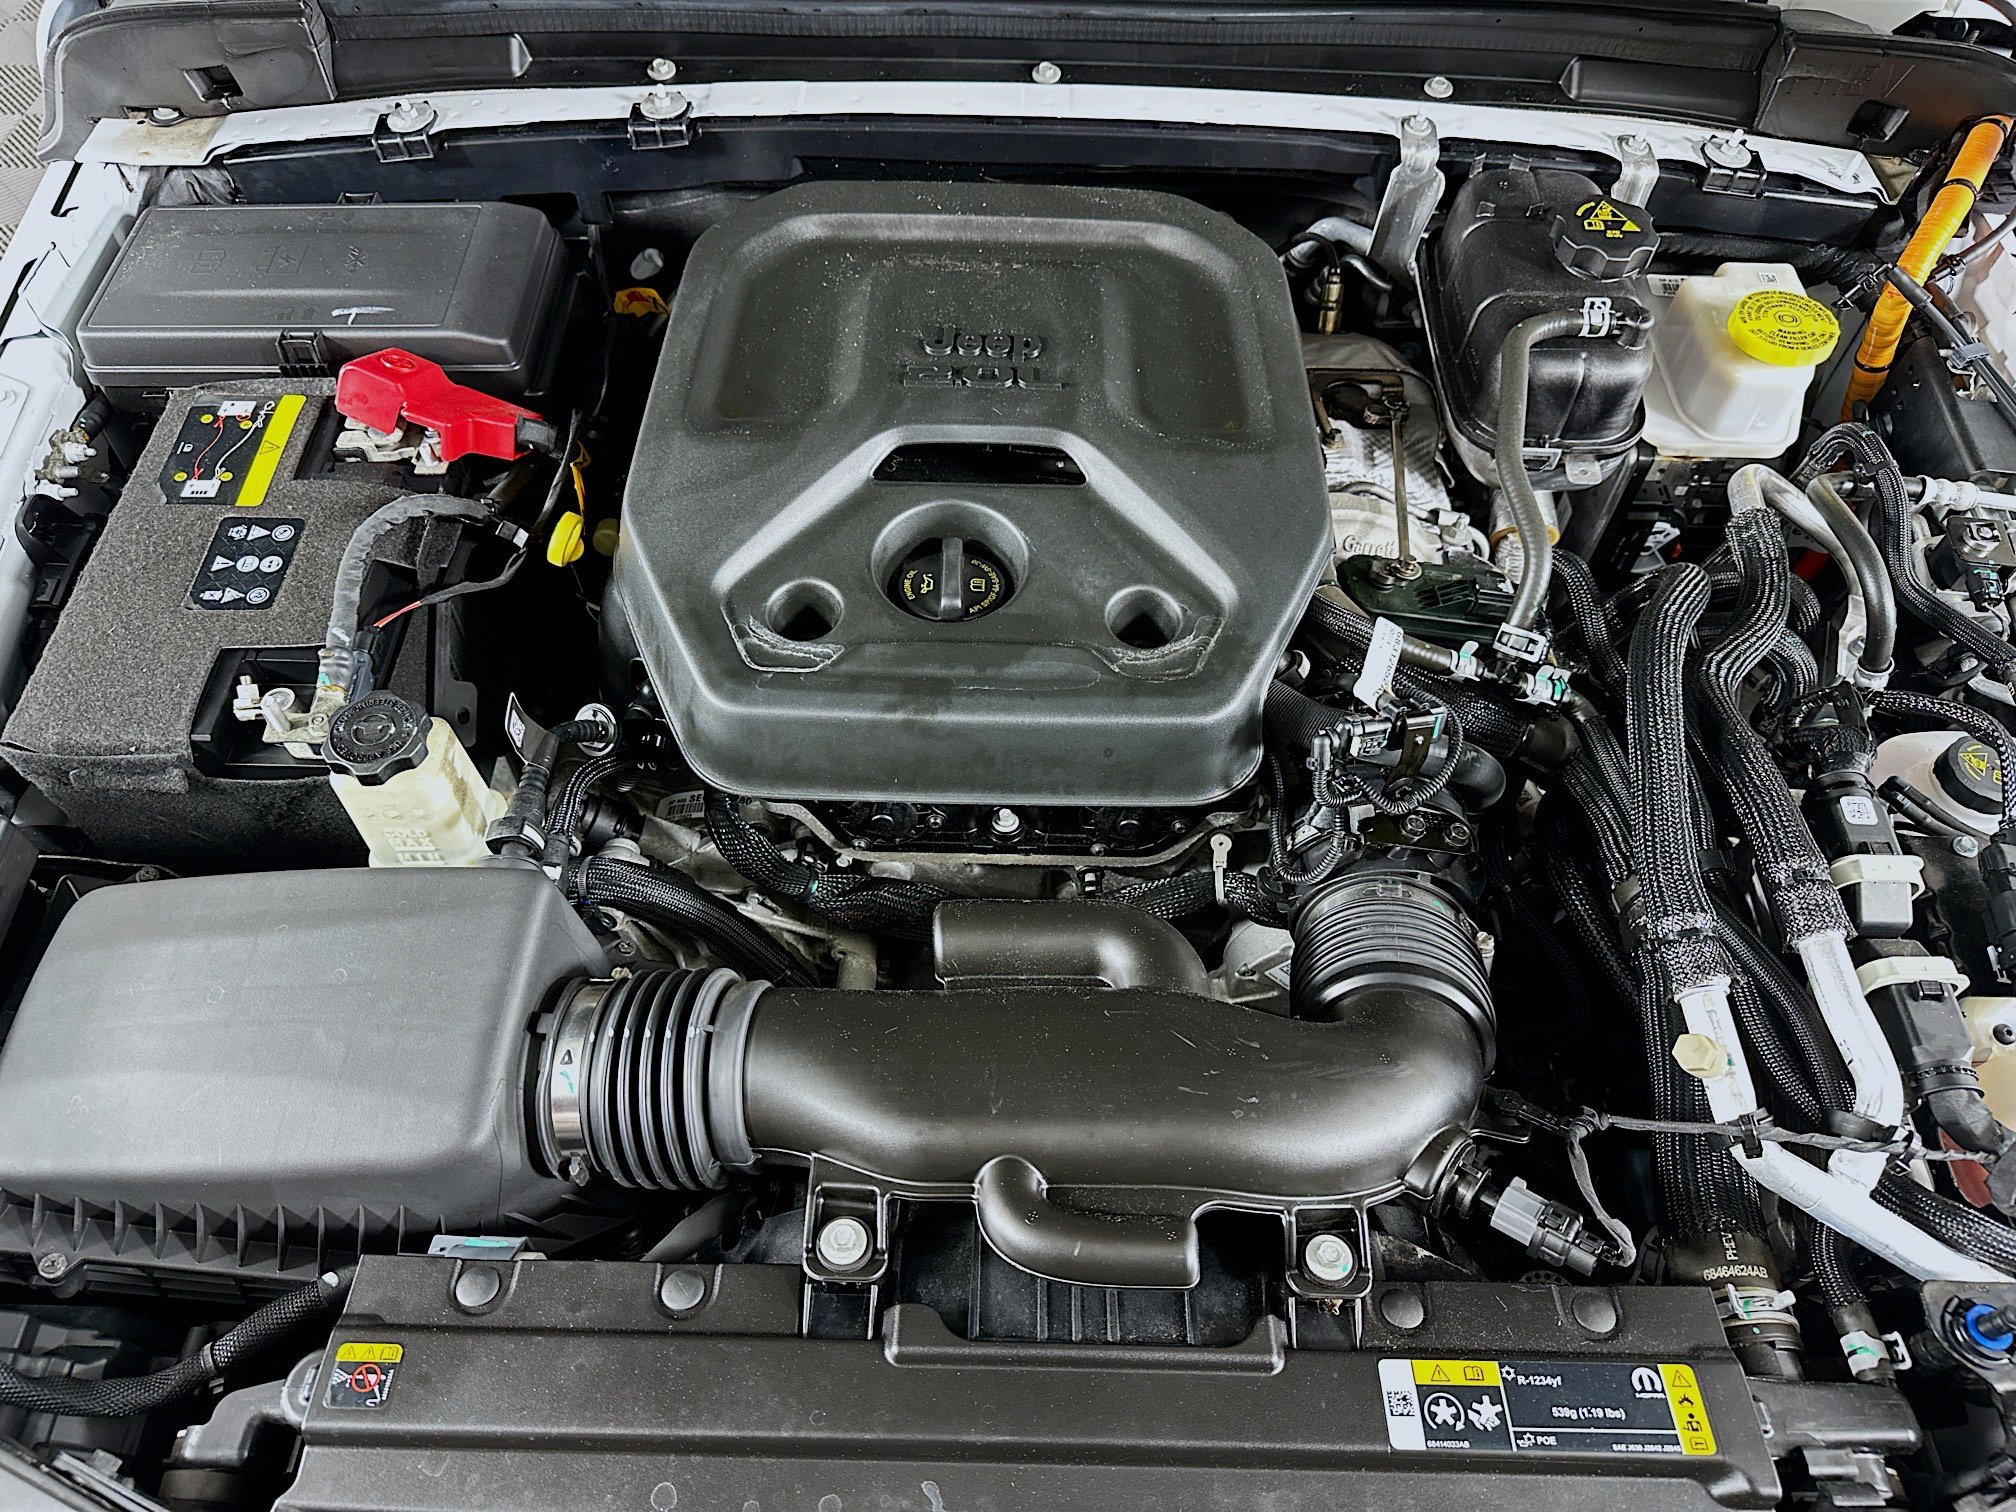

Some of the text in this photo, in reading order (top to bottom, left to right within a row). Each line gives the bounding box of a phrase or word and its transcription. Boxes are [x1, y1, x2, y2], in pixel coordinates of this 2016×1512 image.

[924, 324, 1042, 362] Jeep
[904, 365, 1063, 390] 2.0L
[903, 569, 918, 600] ENGINE OIL
[969, 605, 982, 614] API
[351, 699, 396, 713] STEERING
[388, 838, 437, 852] MAX
[1703, 1264, 1769, 1281] 68464624AB
[1517, 1375, 1563, 1389] R-1234yf
[1551, 1406, 1626, 1421] 539g (1.19 lbs)
[1536, 1435, 1558, 1446] POE
